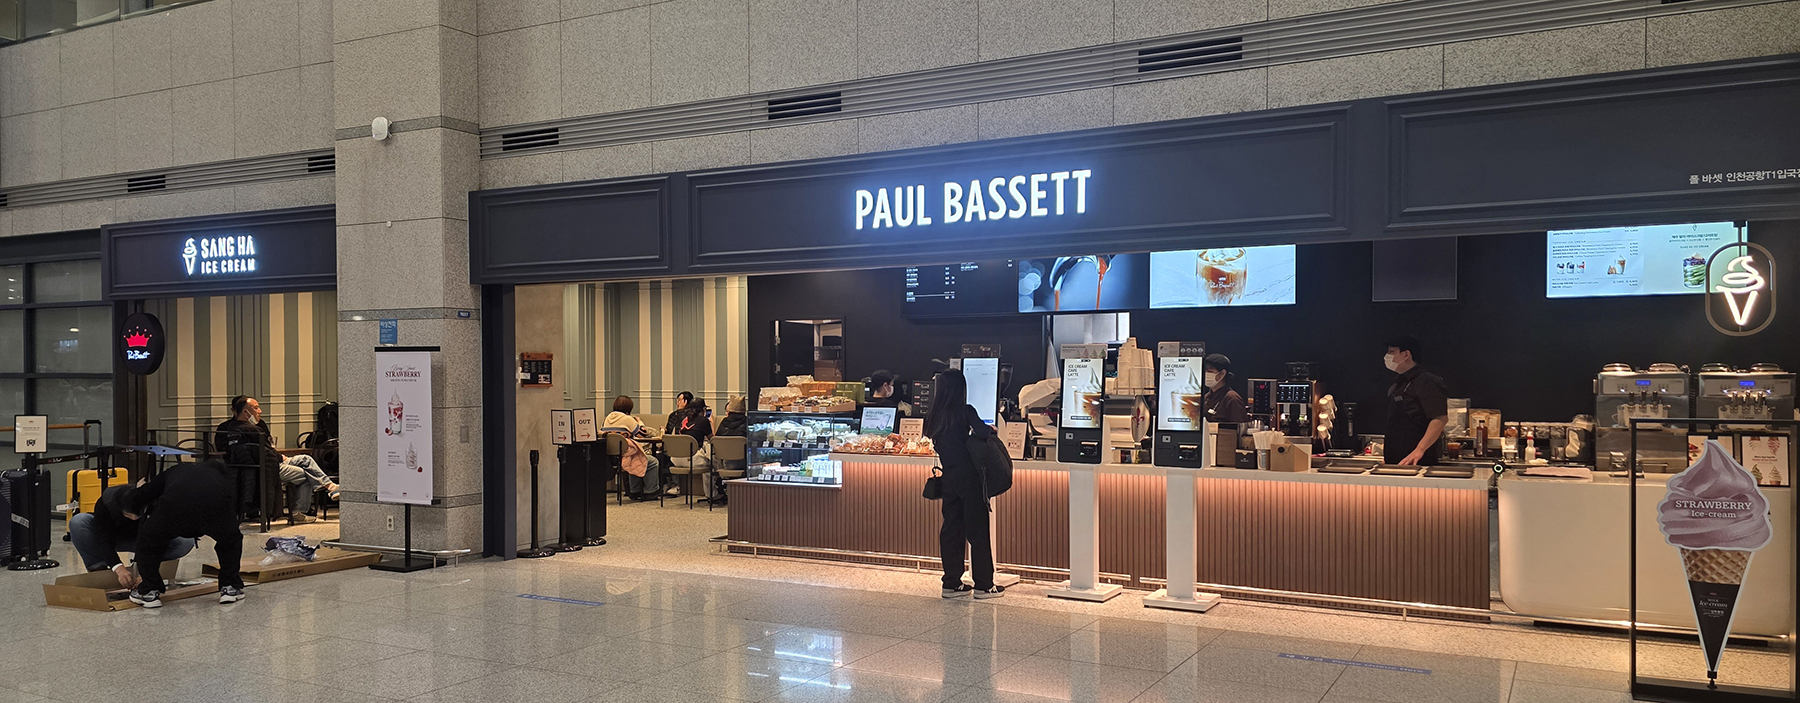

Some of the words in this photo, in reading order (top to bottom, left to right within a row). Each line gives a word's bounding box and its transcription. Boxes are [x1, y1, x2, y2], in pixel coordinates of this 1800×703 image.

[1689, 174, 1699, 185] 폴
[1702, 173, 1723, 184] 바셋
[856, 185, 932, 230] PAUL
[944, 169, 1091, 224] BASSETT
[201, 238, 235, 259] SANG
[237, 235, 256, 256] HA
[201, 260, 218, 275] ICE
[221, 258, 256, 273] CREAM
[1675, 500, 1752, 510] STRAWBERRY
[1691, 510, 1736, 518] Ice-cream
